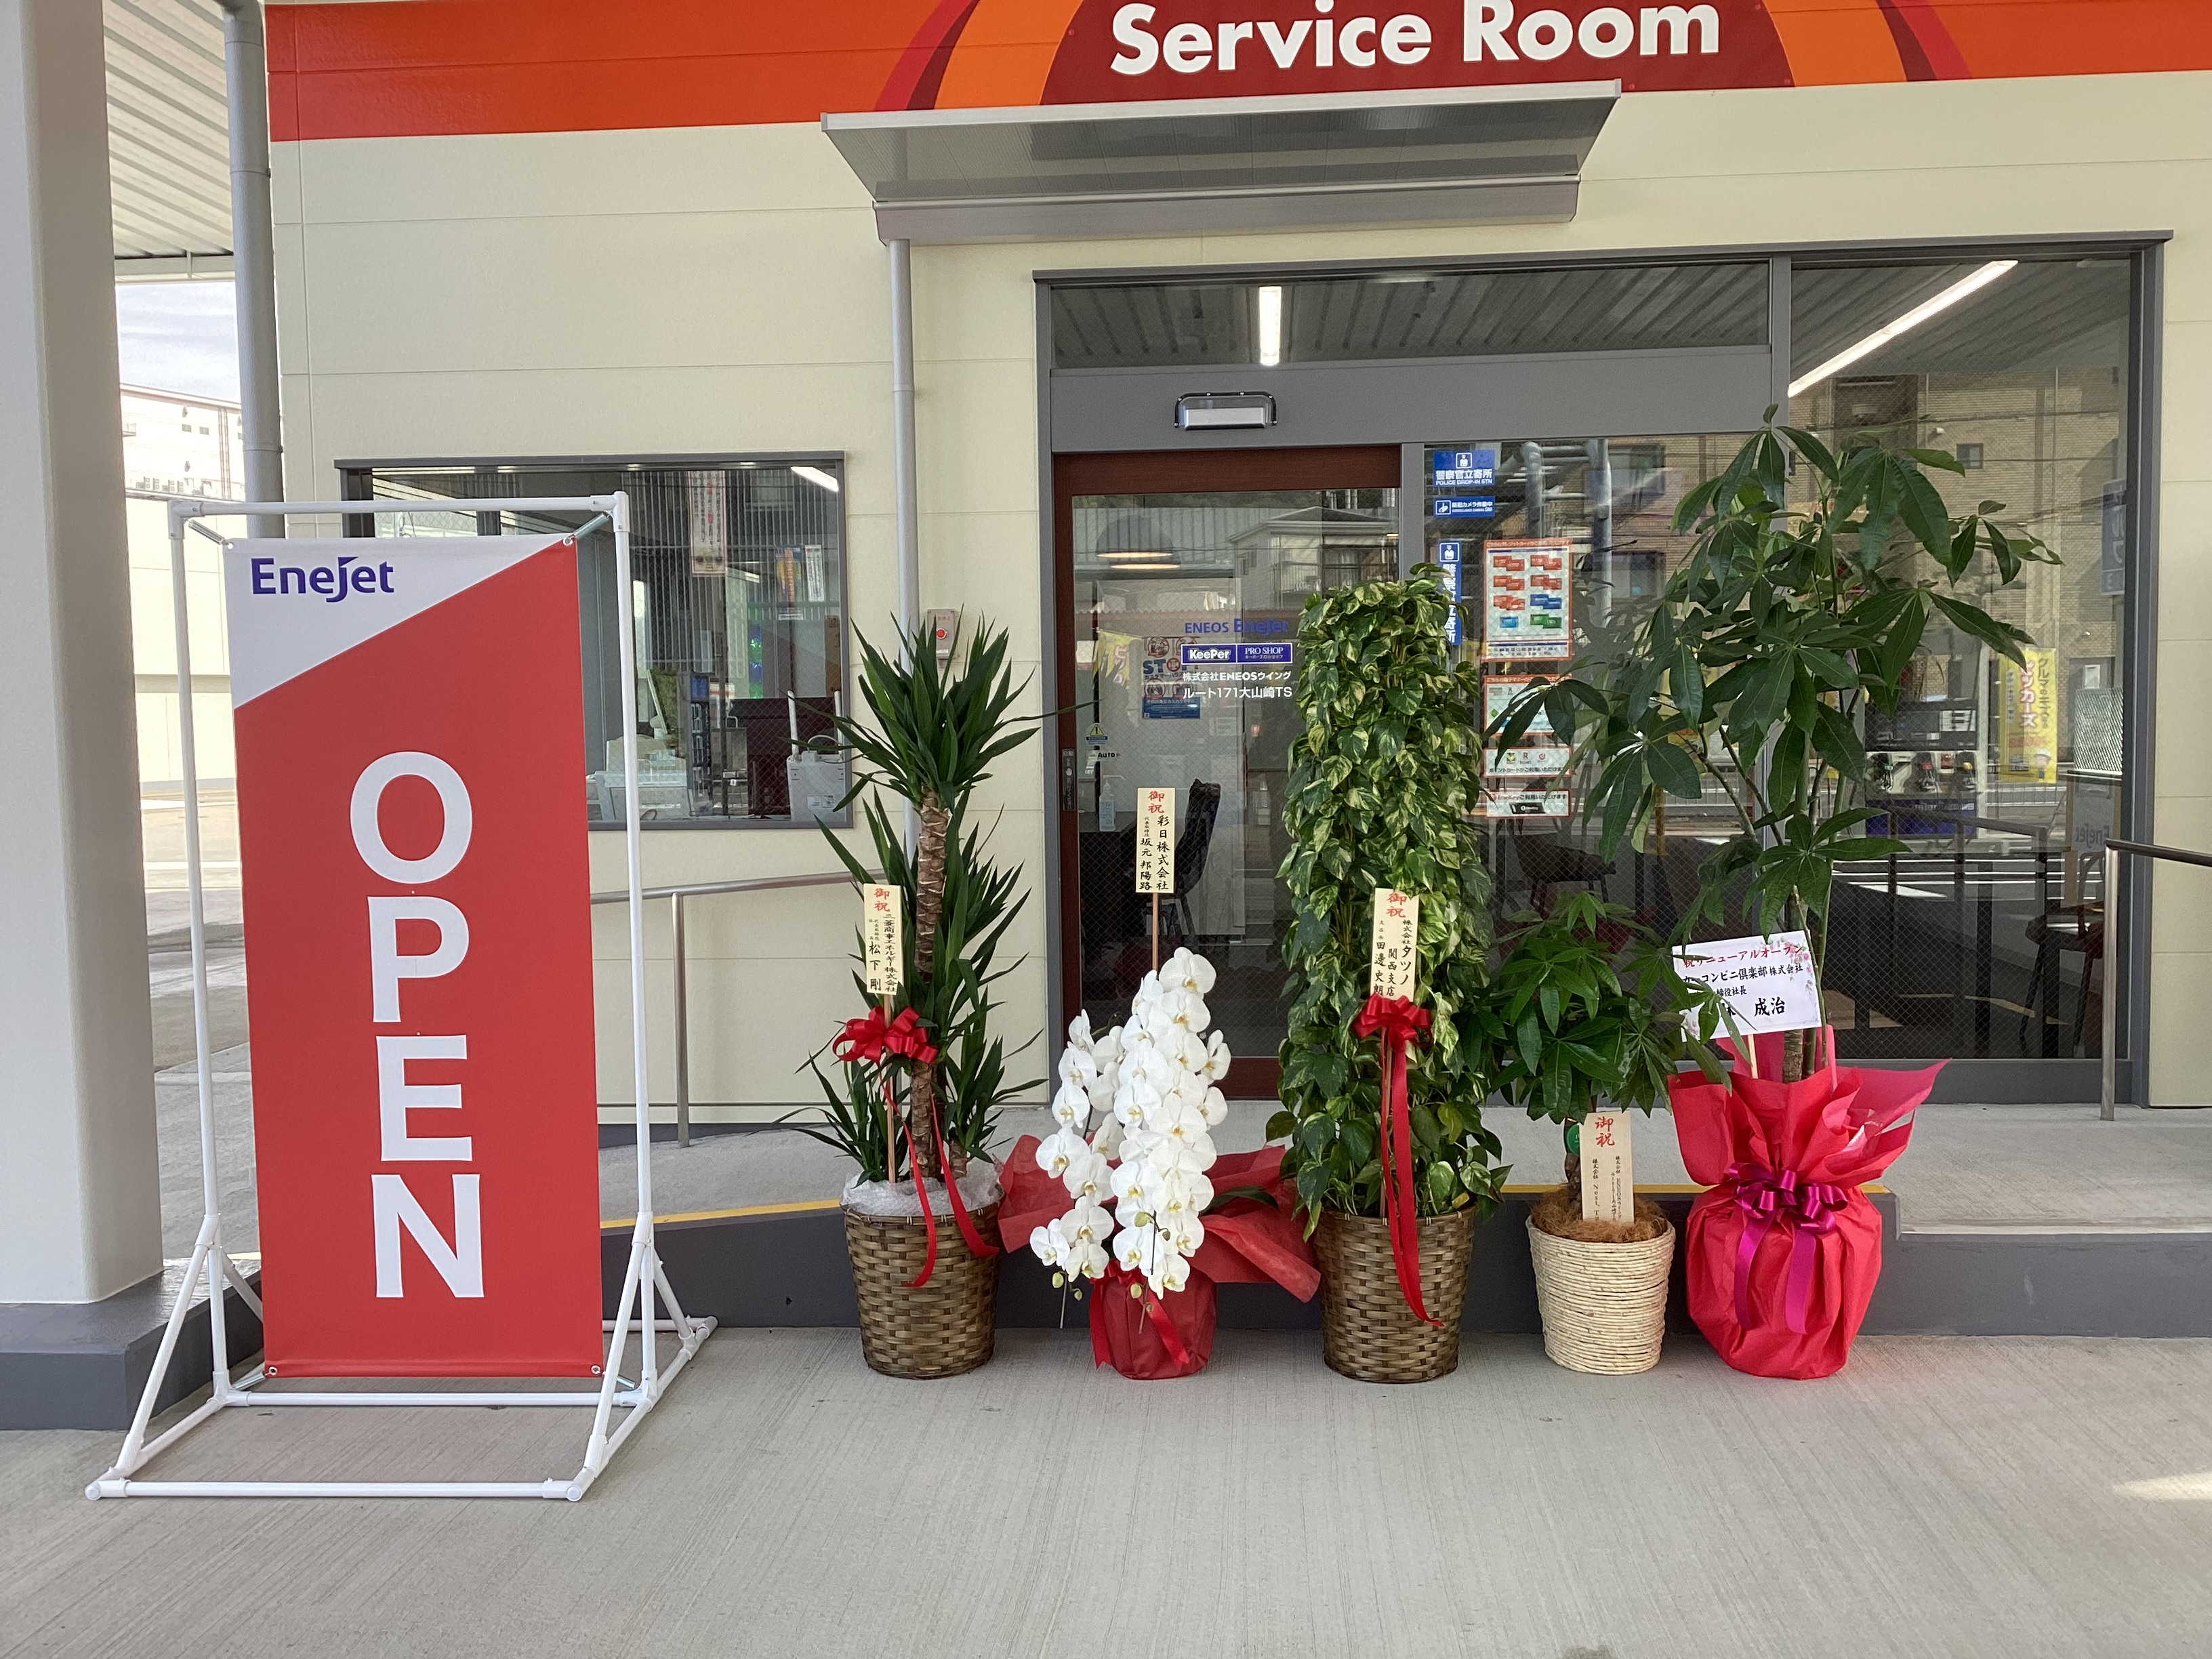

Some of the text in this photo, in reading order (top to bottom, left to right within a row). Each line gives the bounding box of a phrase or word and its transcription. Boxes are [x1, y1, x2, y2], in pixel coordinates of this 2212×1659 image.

[1110, 0, 1720, 75] Service Room
[1435, 468, 1493, 480] 警察官立寄所
[1184, 621, 1229, 634] ENEOS
[1189, 649, 1231, 660] KeePer
[1244, 647, 1284, 655] PRO SHOP
[1183, 671, 1292, 682] 株式会社ENEOSウイング
[1183, 686, 1293, 699] ルート171大山崎TS
[1147, 790, 1166, 814] 御祝
[1155, 815, 1170, 891] 彩日株式会社
[874, 887, 890, 912] 御祝
[1386, 893, 1408, 918] 御祝
[1754, 996, 1786, 1017] 成治
[350, 750, 485, 1298] OPEN
[1594, 1115, 1616, 1148] 御祝
